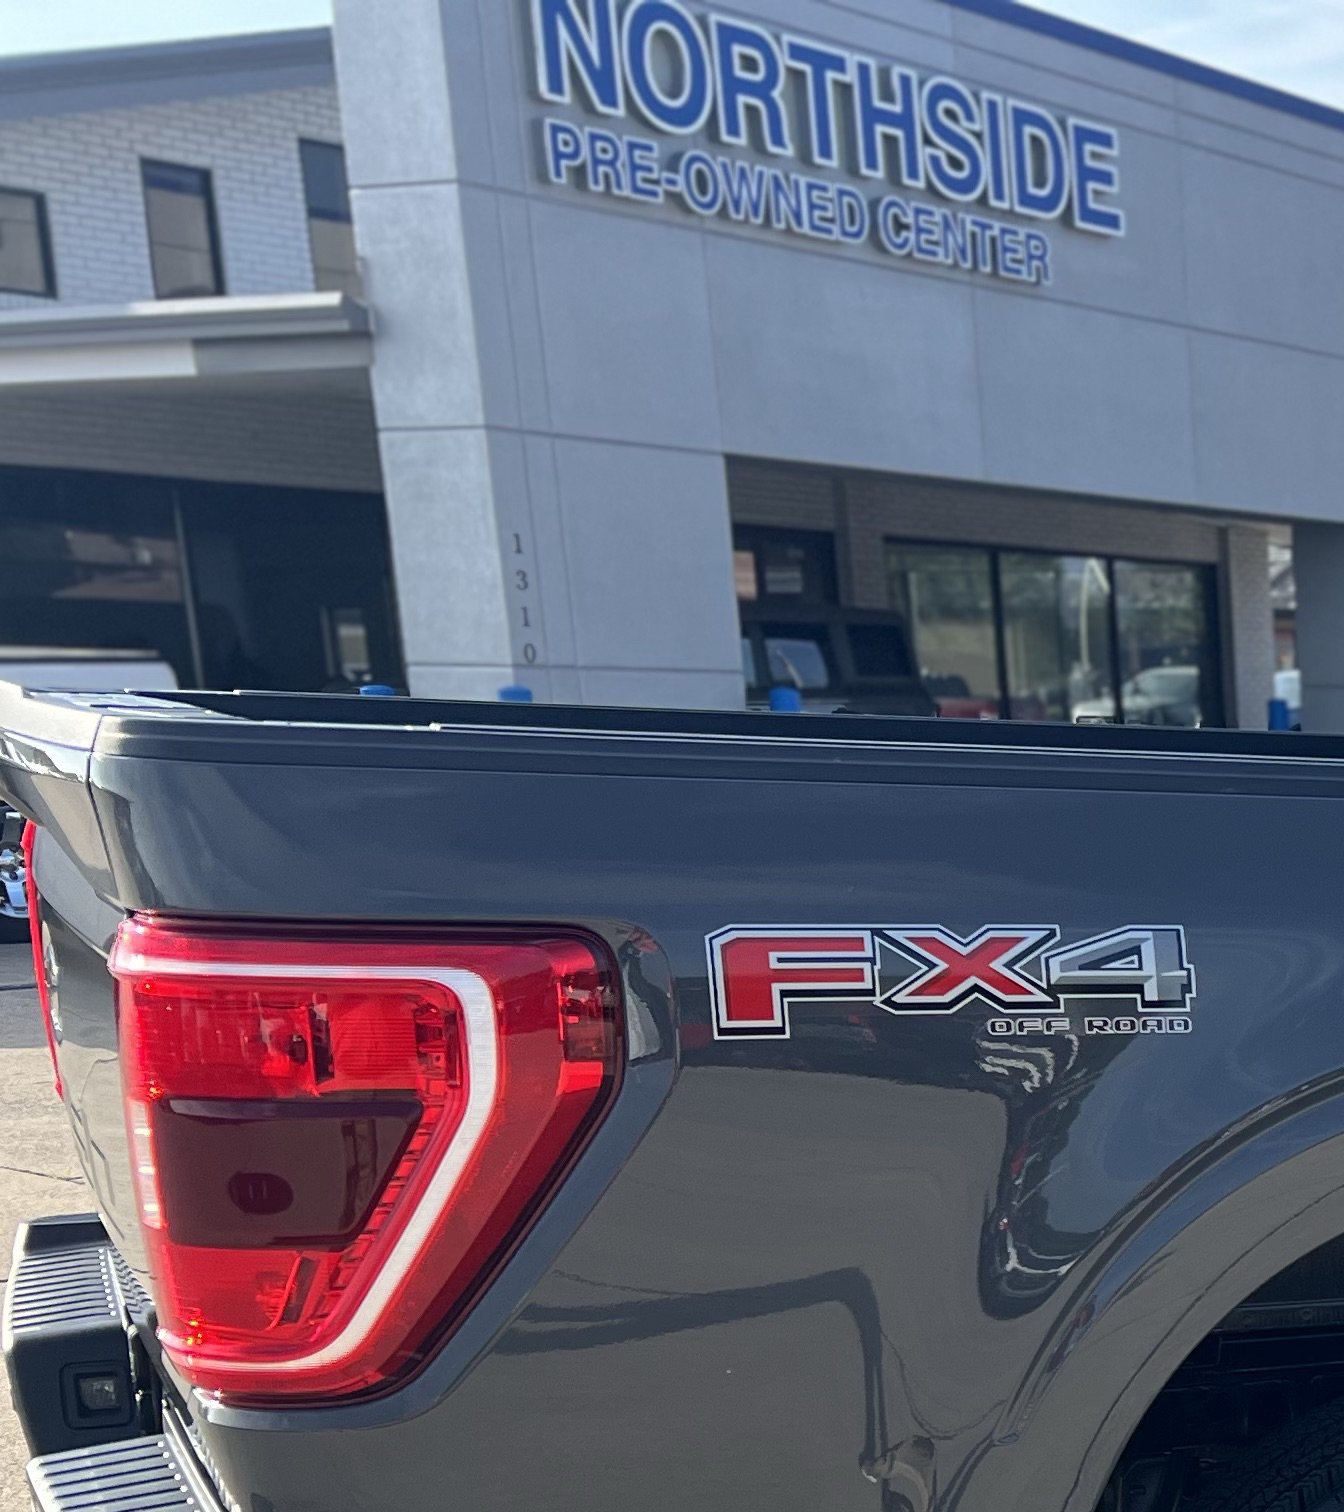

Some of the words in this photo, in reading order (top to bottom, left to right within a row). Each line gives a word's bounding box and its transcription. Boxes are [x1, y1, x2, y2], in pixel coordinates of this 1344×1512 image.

[531, 0, 1125, 237] NORTHSIDE
[544, 117, 868, 243] PRE-OWNED
[878, 196, 1051, 284] CENTER
[704, 924, 1196, 1040] FX4
[987, 1017, 1069, 1035] OFF
[1084, 1016, 1193, 1034] ROAD
